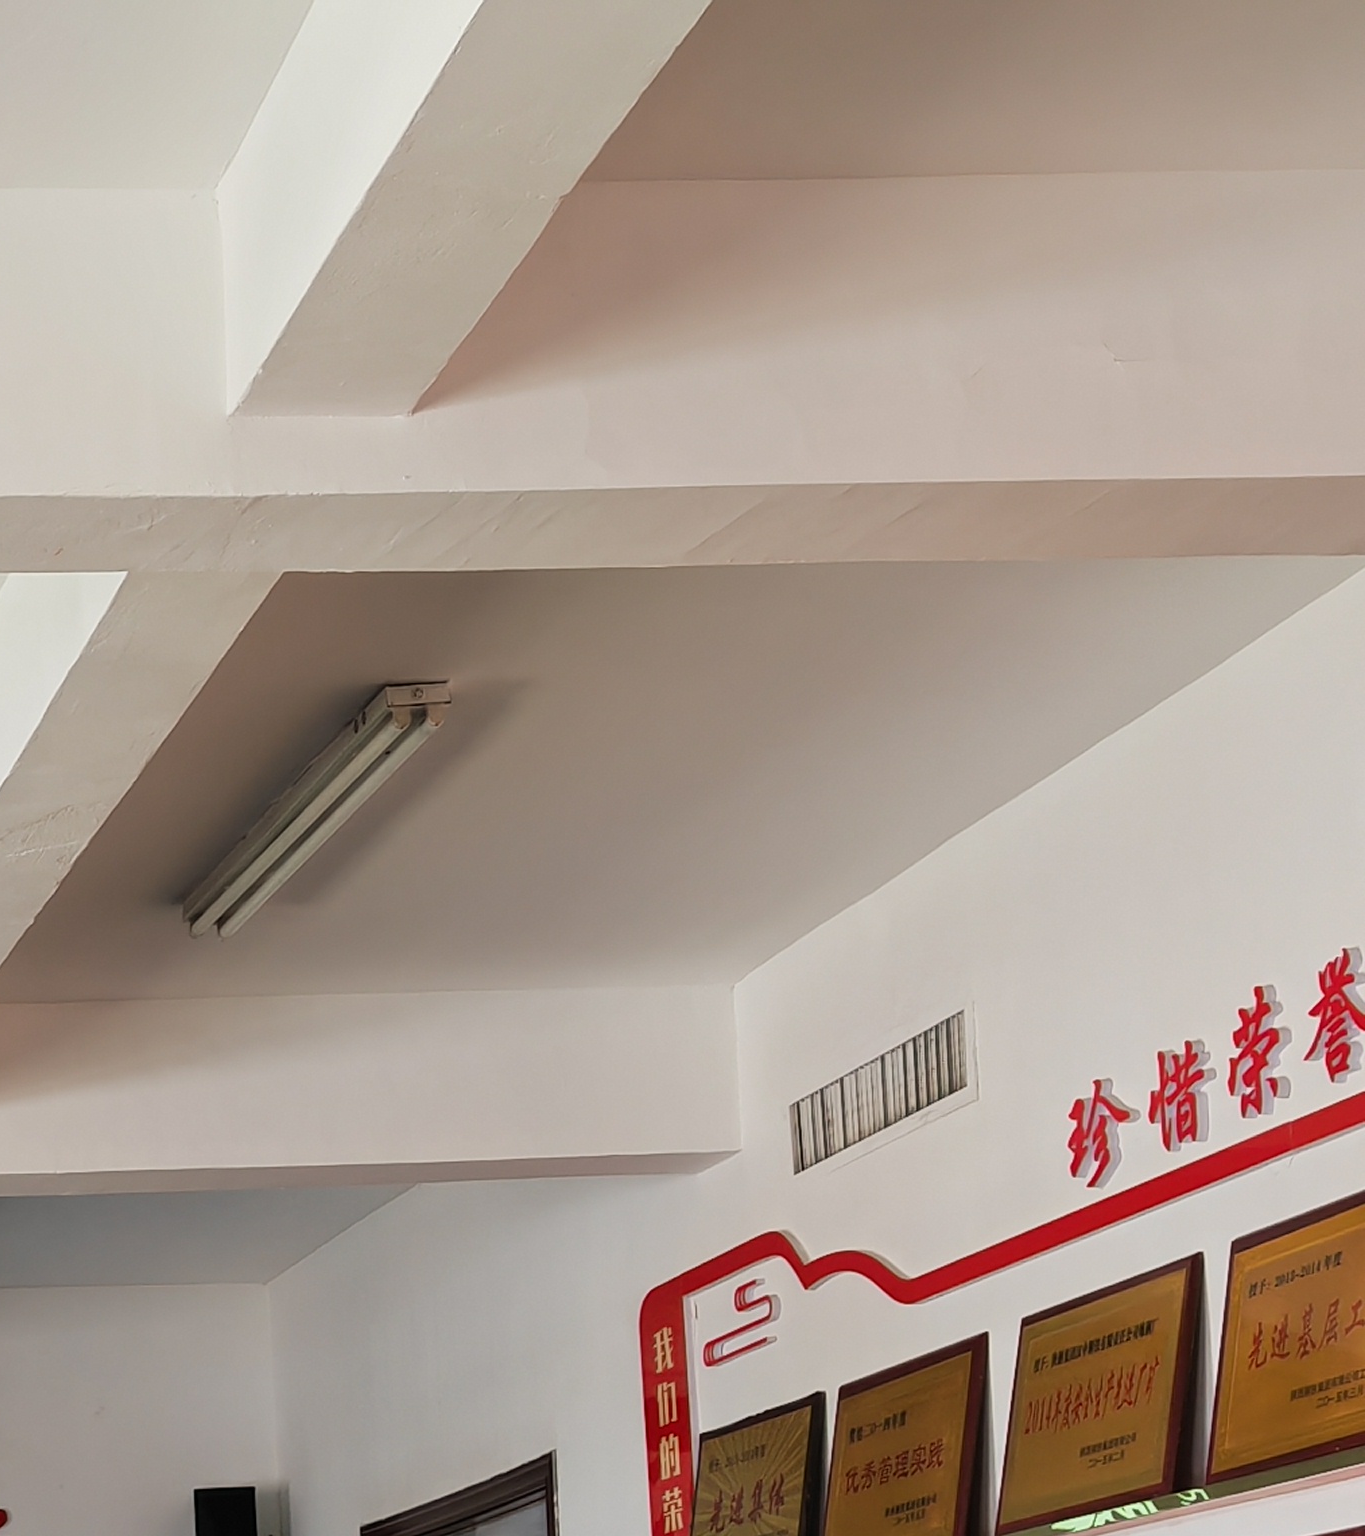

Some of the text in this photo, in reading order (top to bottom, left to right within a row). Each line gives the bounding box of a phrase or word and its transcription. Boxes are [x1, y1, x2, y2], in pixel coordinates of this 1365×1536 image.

[1068, 948, 1365, 1187] 珍惜荣誉
[845, 1438, 944, 1495] 优秀管理实践
